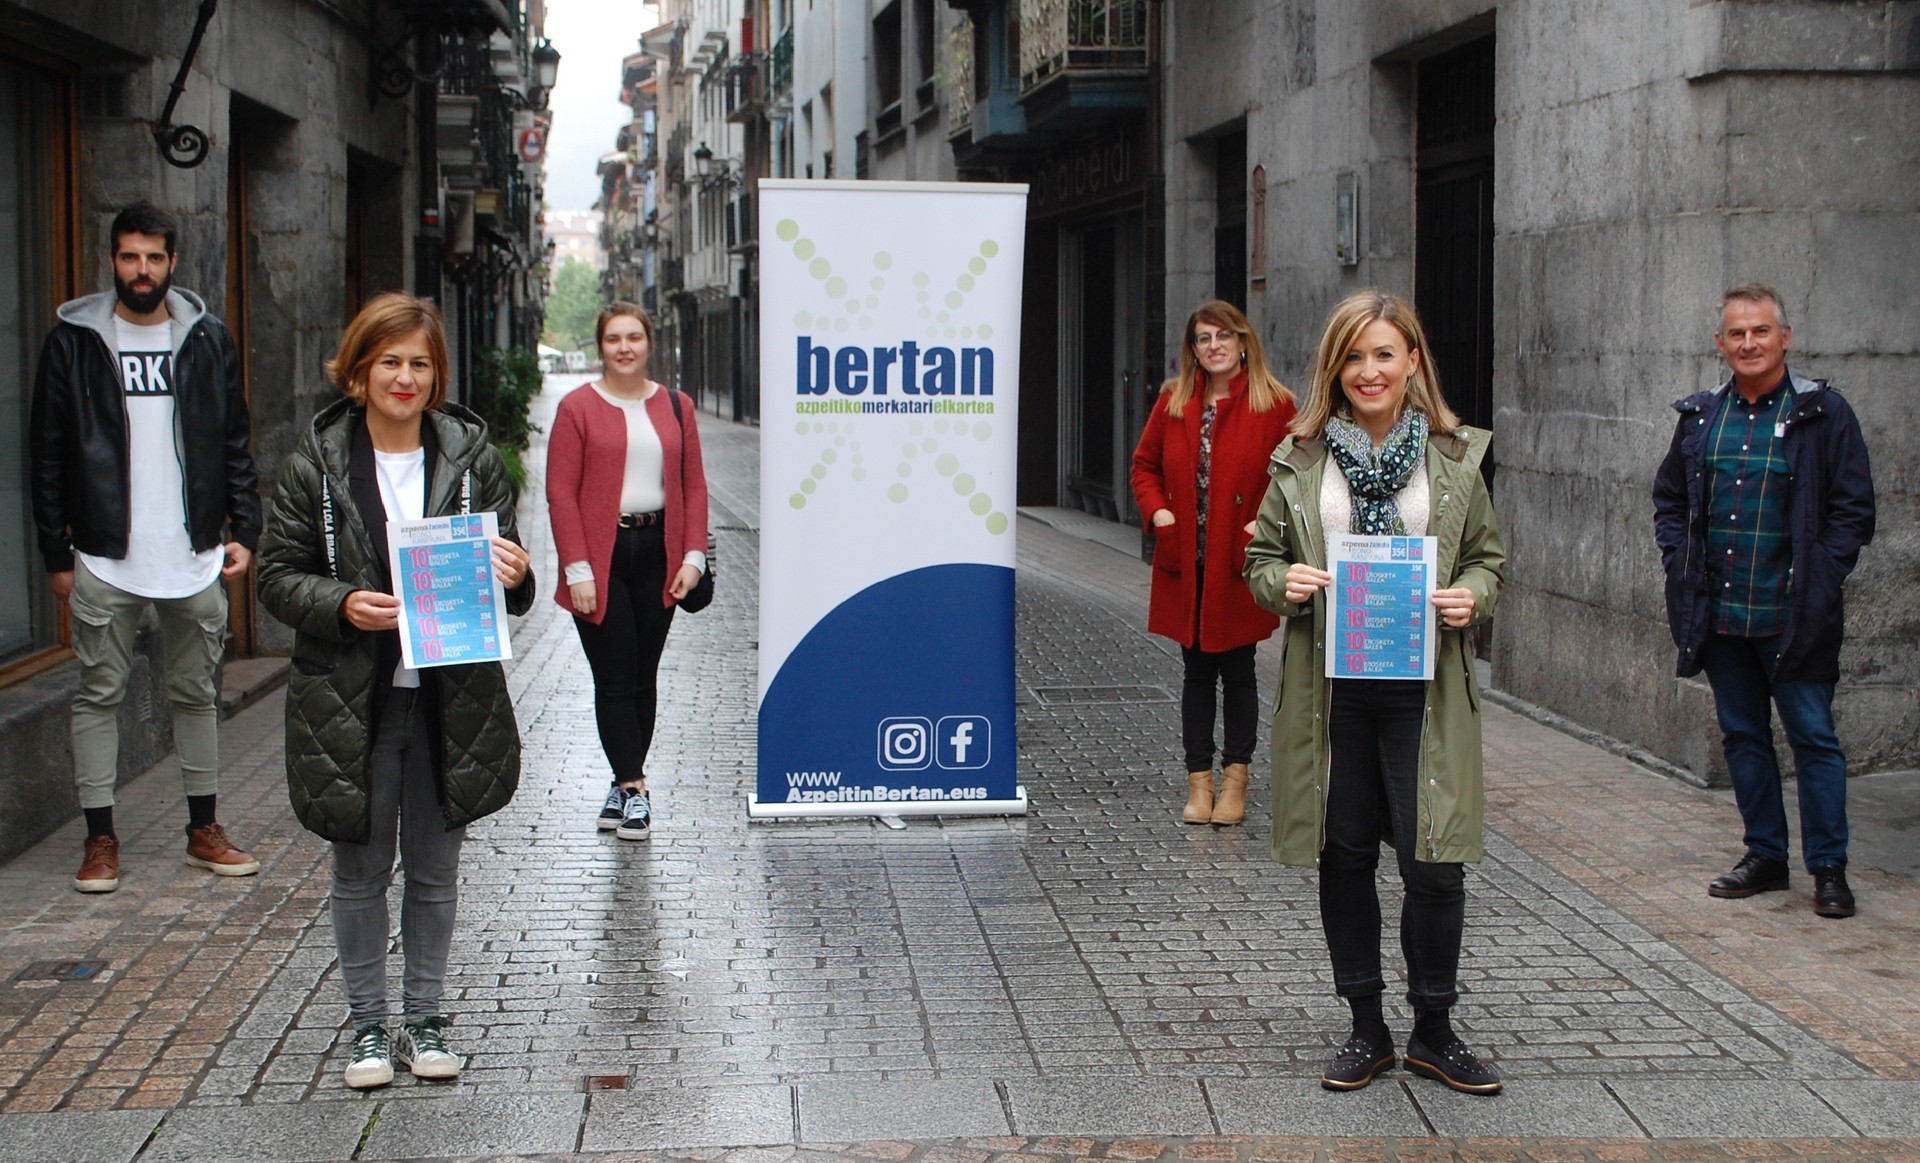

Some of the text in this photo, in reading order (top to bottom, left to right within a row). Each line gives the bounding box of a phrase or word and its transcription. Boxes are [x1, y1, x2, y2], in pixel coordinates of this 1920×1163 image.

[796, 336, 994, 395] bertan
[323, 509, 334, 532] LOLA
[1391, 547, 1406, 557] 35€
[785, 785, 988, 803] AzpeitinBertan.eus
